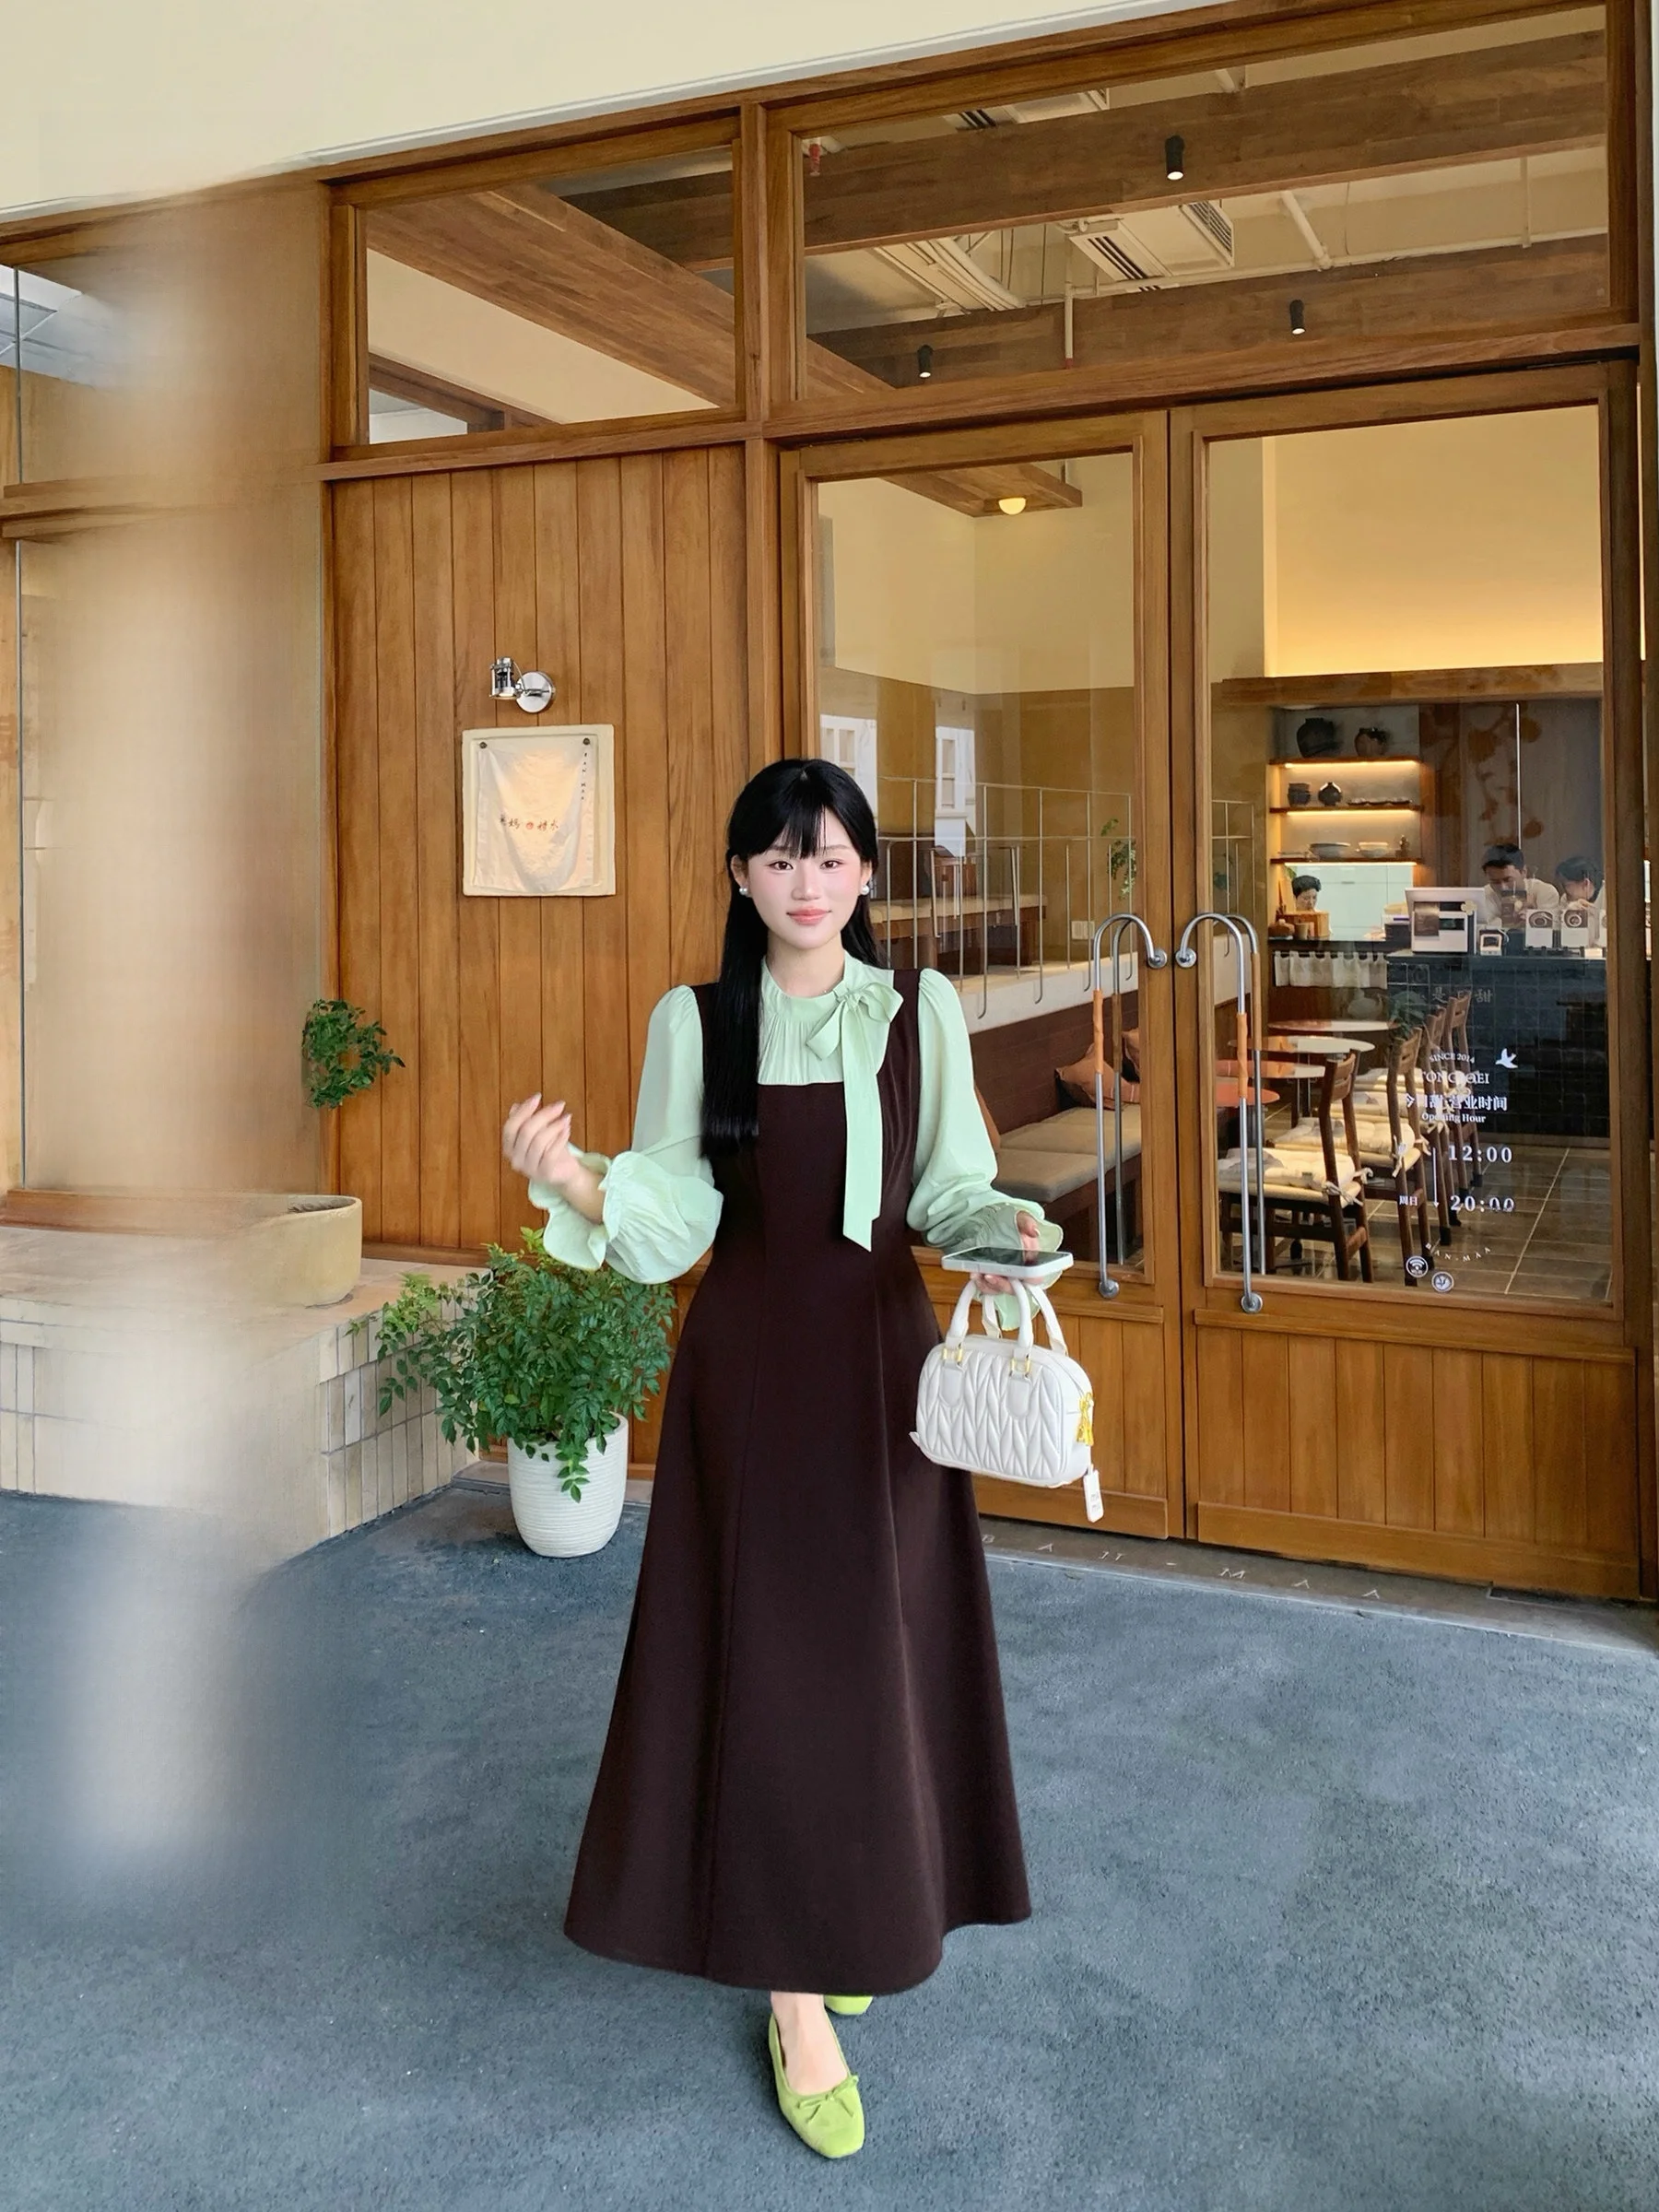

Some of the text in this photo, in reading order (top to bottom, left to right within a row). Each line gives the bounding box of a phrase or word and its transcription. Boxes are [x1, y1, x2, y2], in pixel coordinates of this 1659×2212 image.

[1430, 1053, 1476, 1064] SINCE 2014
[1421, 1112, 1487, 1124] Oping Hour
[1448, 1145, 1512, 1163] 12:00
[1399, 1195, 1418, 1206] 周日
[1450, 1195, 1514, 1213] 20:00
